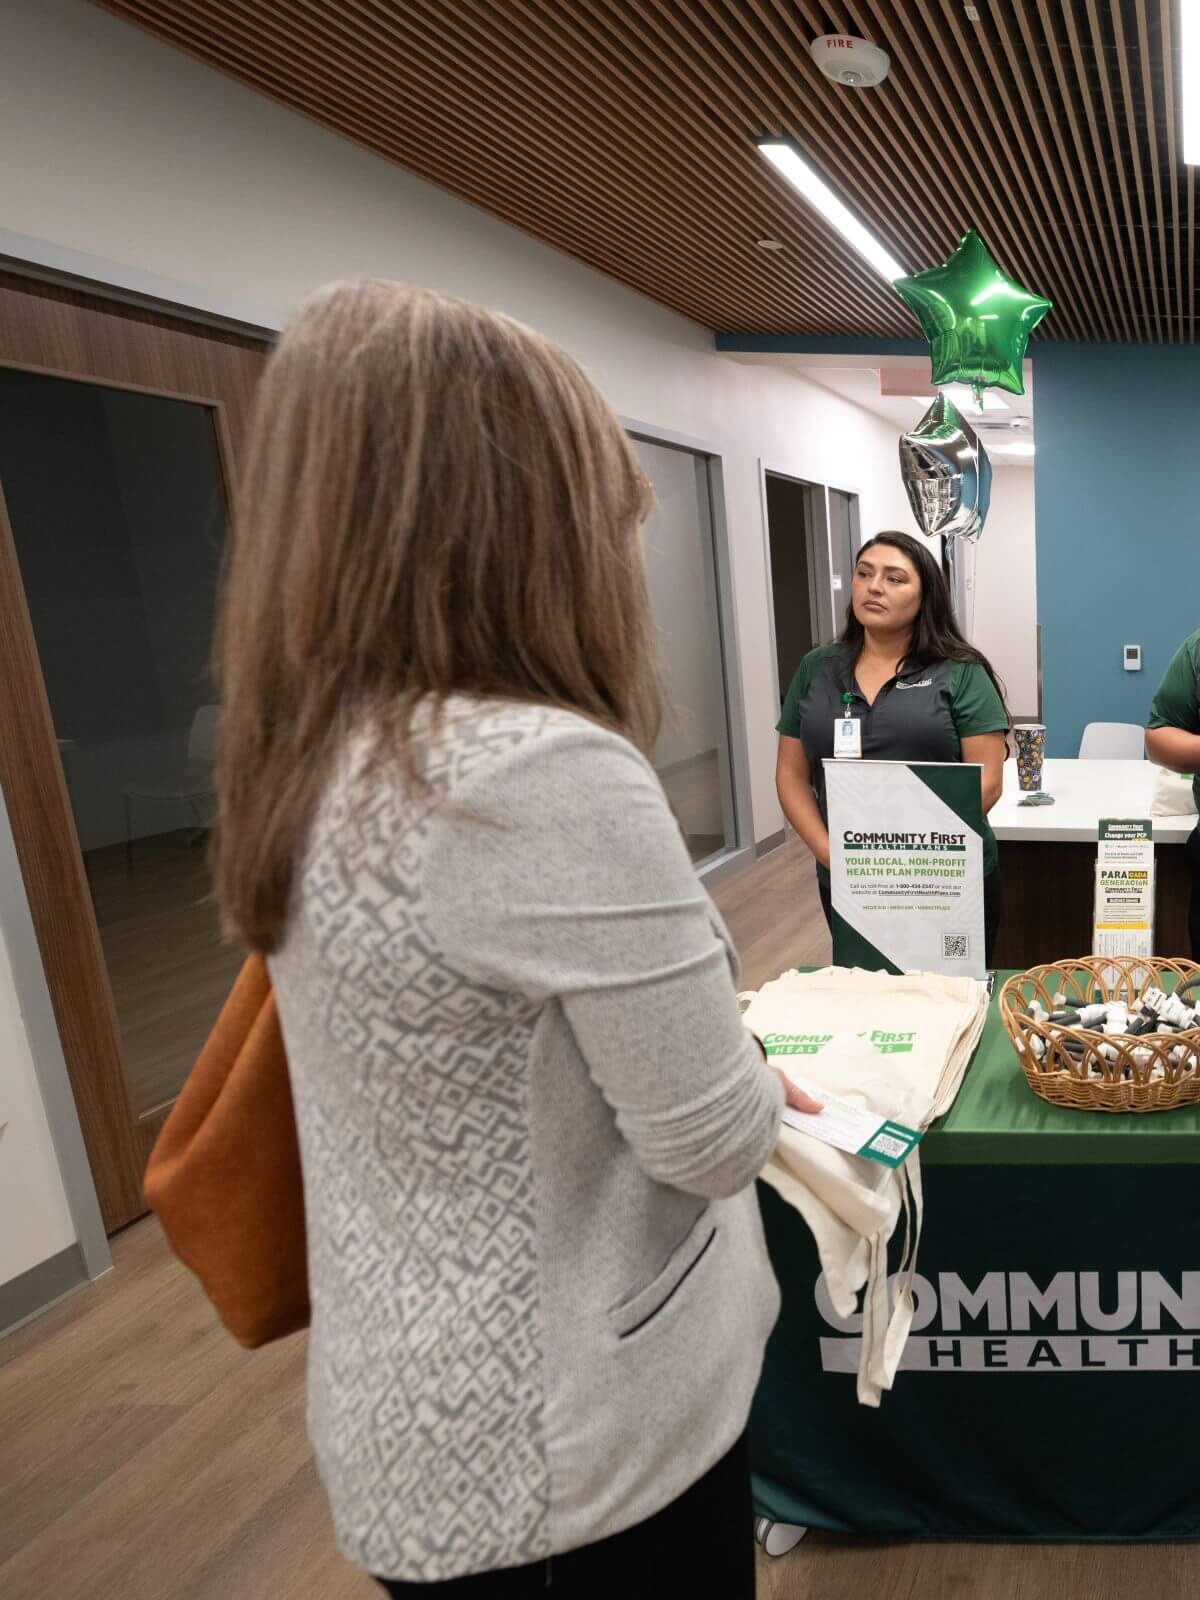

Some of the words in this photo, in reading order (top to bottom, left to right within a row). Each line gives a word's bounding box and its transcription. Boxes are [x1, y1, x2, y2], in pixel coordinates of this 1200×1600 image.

[826, 39, 854, 49] FIRE
[843, 830, 927, 844] COMMUNITY
[930, 832, 966, 845] FIRST
[845, 857, 871, 865] YOUR
[873, 858, 906, 867] LOCAL,
[908, 858, 966, 867] NON-PROFIT
[846, 868, 884, 876] HEALTH
[886, 868, 912, 876] PLAN
[914, 868, 965, 878] PROVIDER!
[1101, 871, 1127, 879] PARA
[870, 1030, 917, 1043] FIRST
[775, 1045, 815, 1054] HEAL
[928, 1339, 1200, 1368] HEALTH
